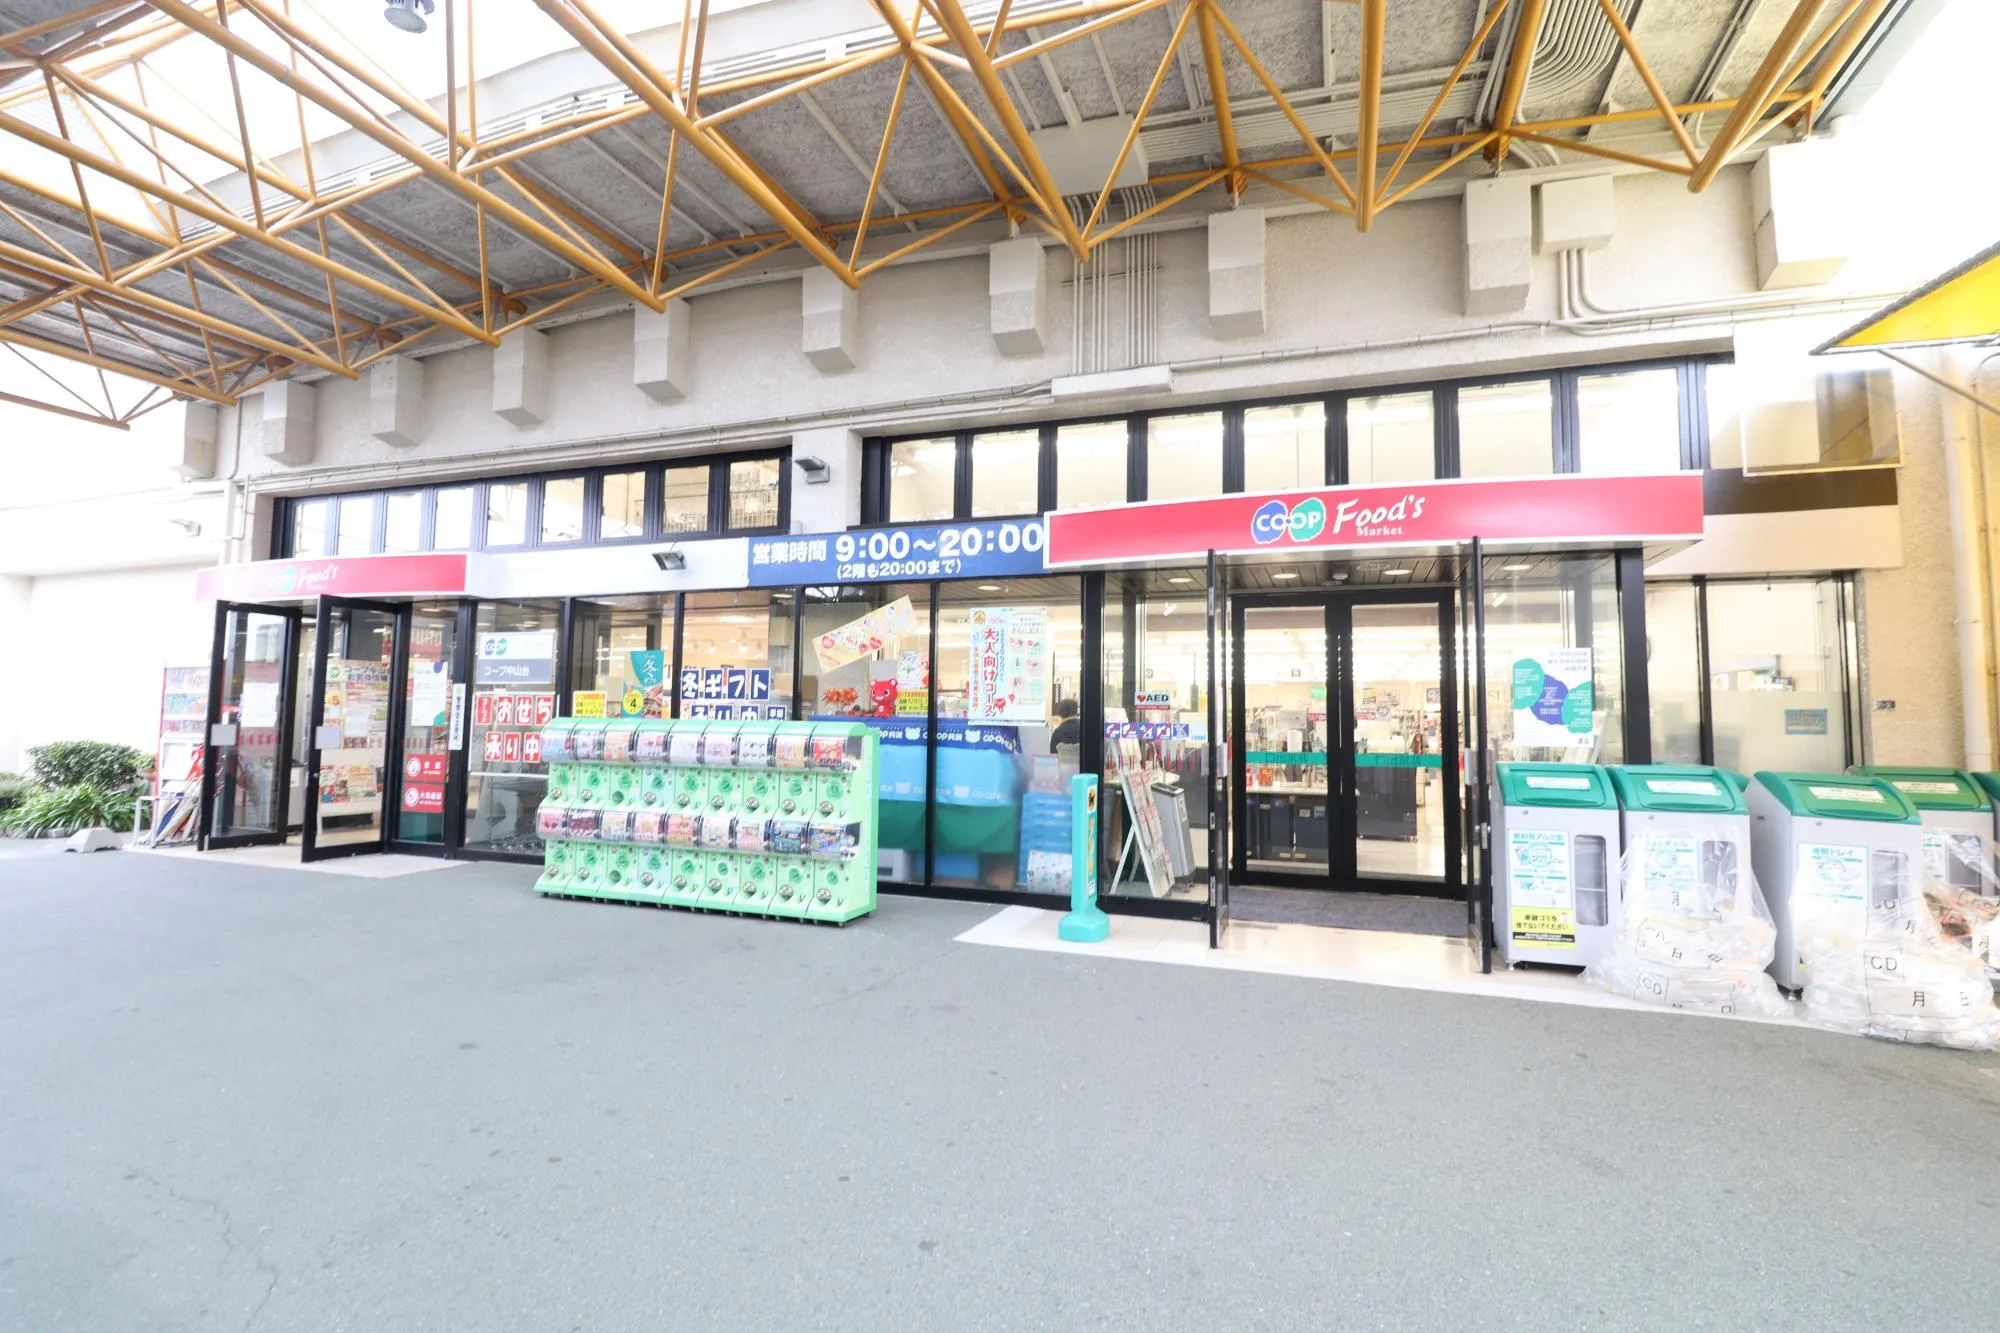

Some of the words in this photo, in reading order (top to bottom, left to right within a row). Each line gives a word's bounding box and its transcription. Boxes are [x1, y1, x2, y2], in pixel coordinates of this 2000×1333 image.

[1332, 494, 1427, 535] Food's
[1356, 525, 1403, 537] Market
[752, 538, 827, 565] 営業時間
[836, 558, 962, 581] (2階も20:00まで)
[484, 664, 530, 677] コープ中山台
[984, 628, 997, 716] 大人向けコース
[683, 671, 768, 699] 冬ギフト
[1146, 694, 1169, 702] AED
[497, 697, 552, 724] おせち
[486, 733, 539, 760] 承り中
[1516, 921, 1569, 931] 捨てないでください
[1870, 955, 1898, 971] CD
[1912, 990, 1925, 1008] 月
